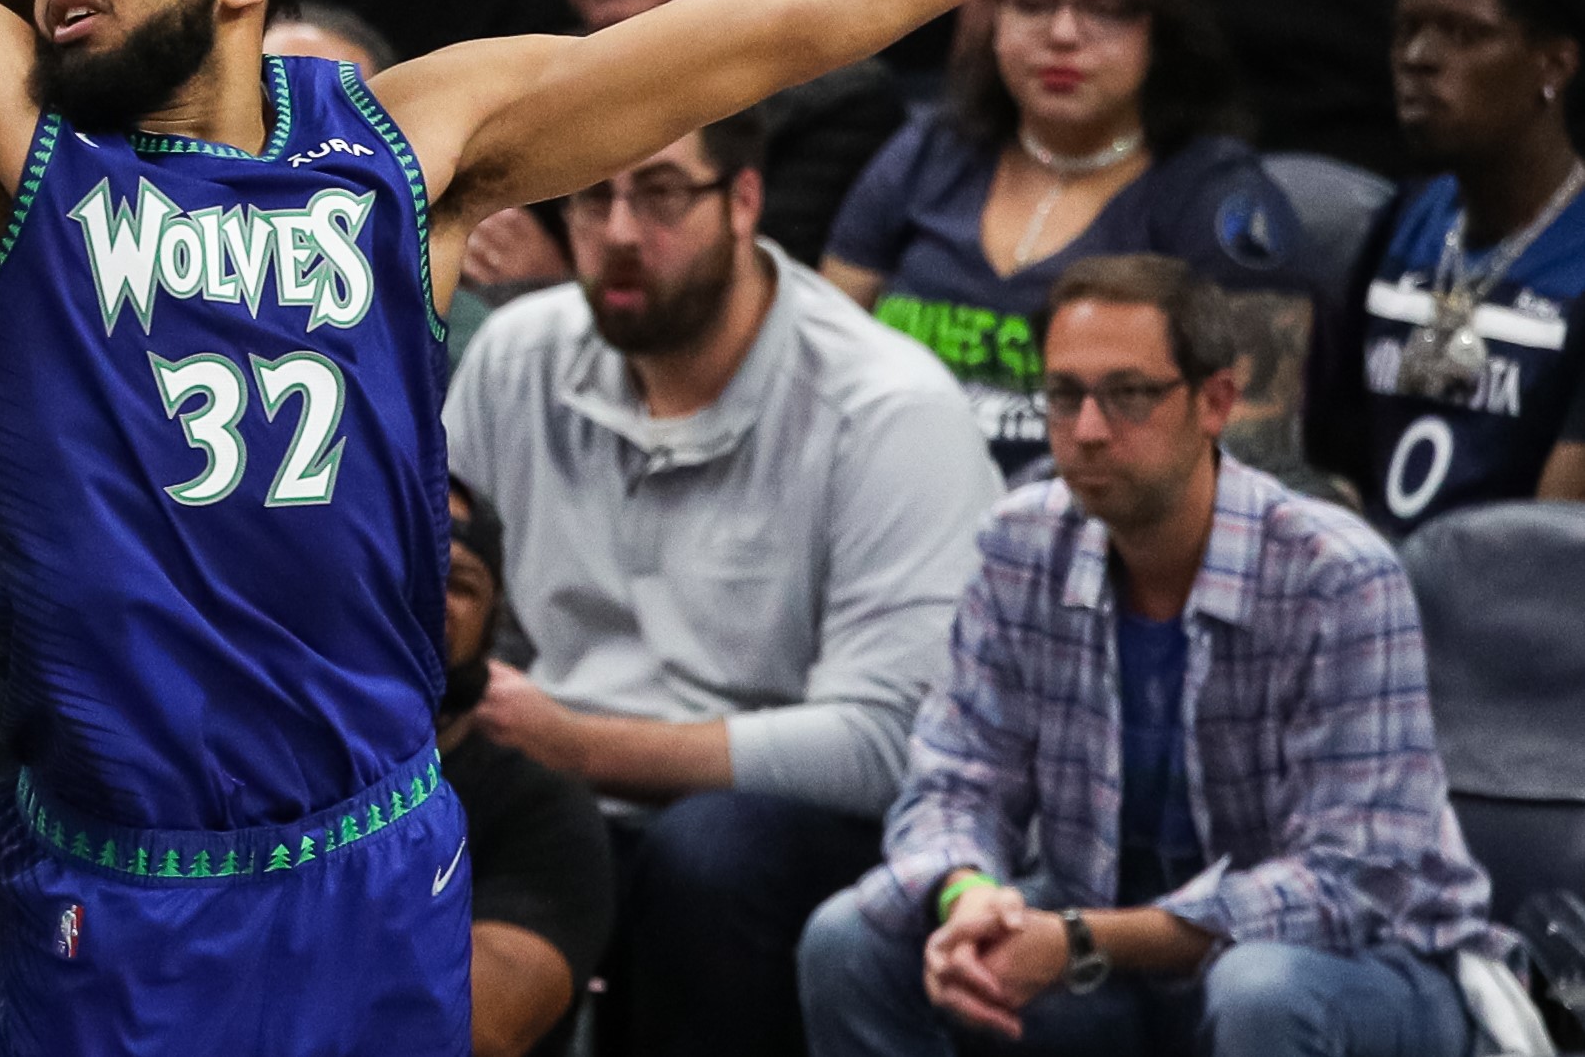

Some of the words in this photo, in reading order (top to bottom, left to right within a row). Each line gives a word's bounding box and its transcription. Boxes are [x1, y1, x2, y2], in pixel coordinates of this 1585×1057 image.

[66, 176, 376, 338] WOLVES
[146, 350, 347, 508] 32
[1387, 415, 1454, 519] 0
